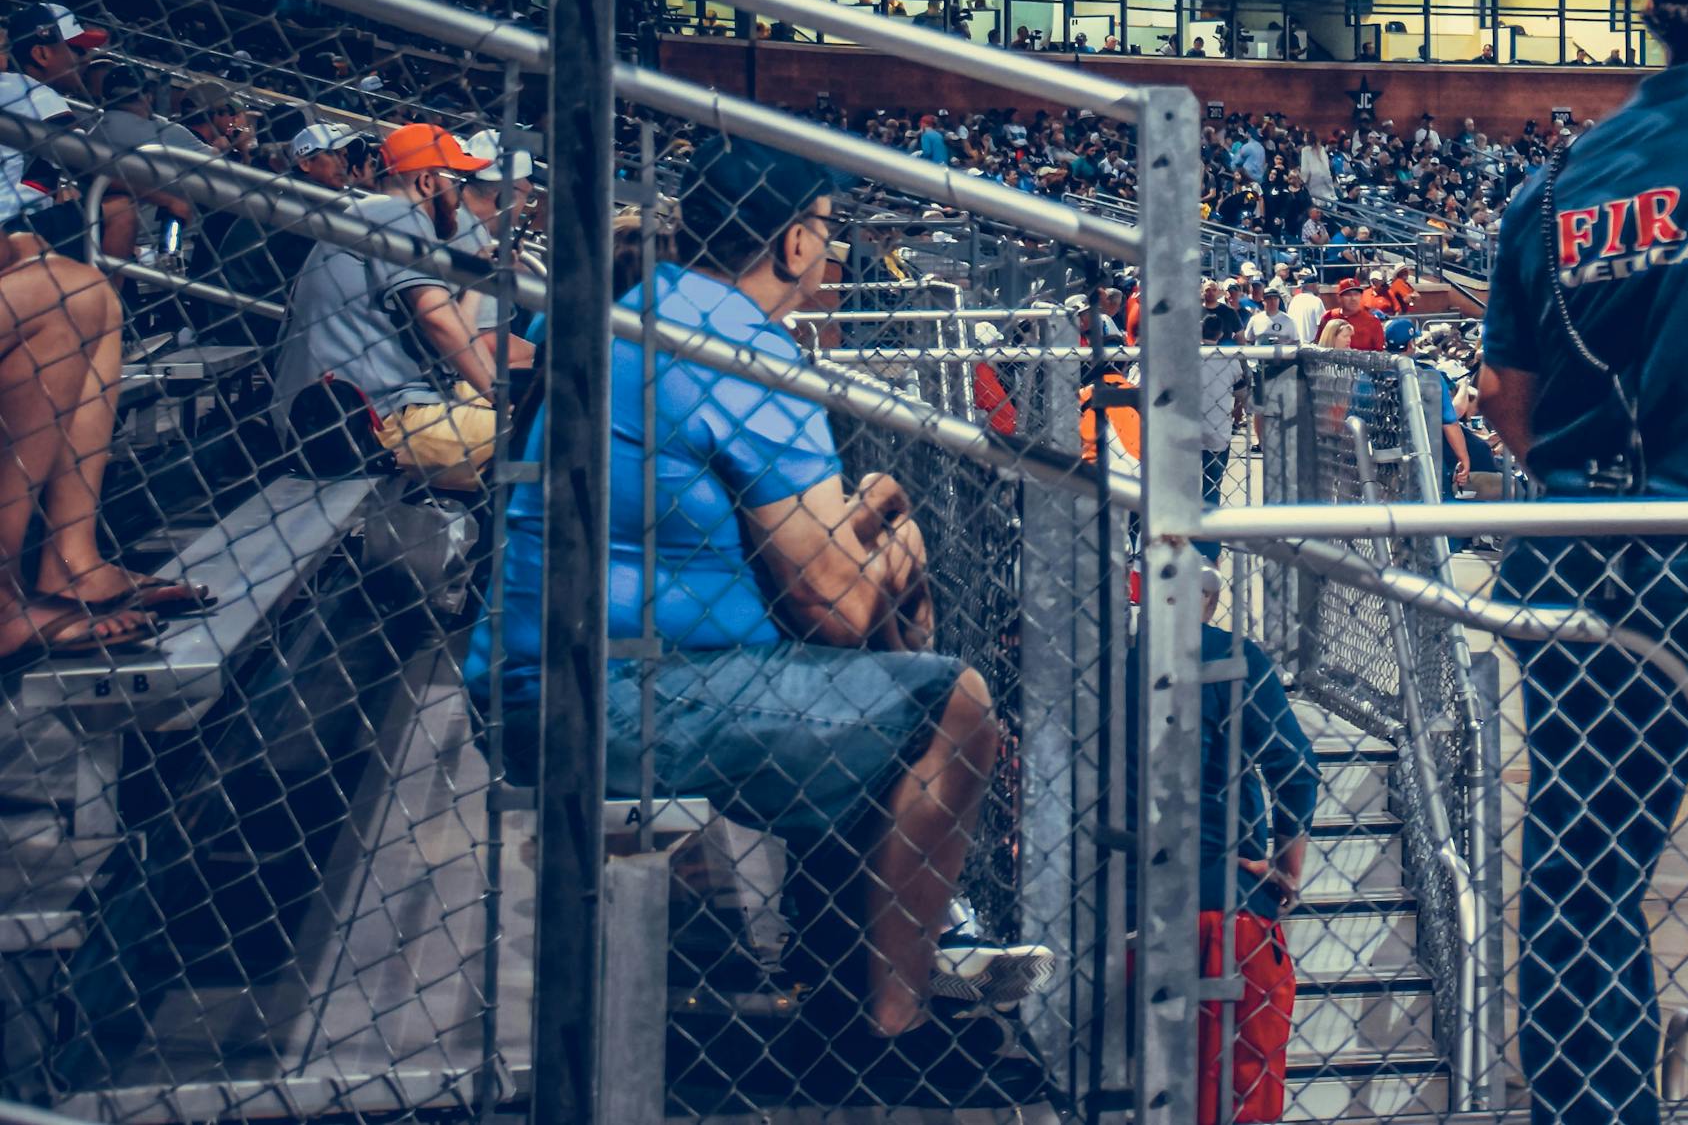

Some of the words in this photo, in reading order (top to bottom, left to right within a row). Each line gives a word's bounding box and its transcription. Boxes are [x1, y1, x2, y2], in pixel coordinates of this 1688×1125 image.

[1357, 92, 1373, 109] JC
[133, 674, 149, 694] B
[625, 806, 642, 826] A
